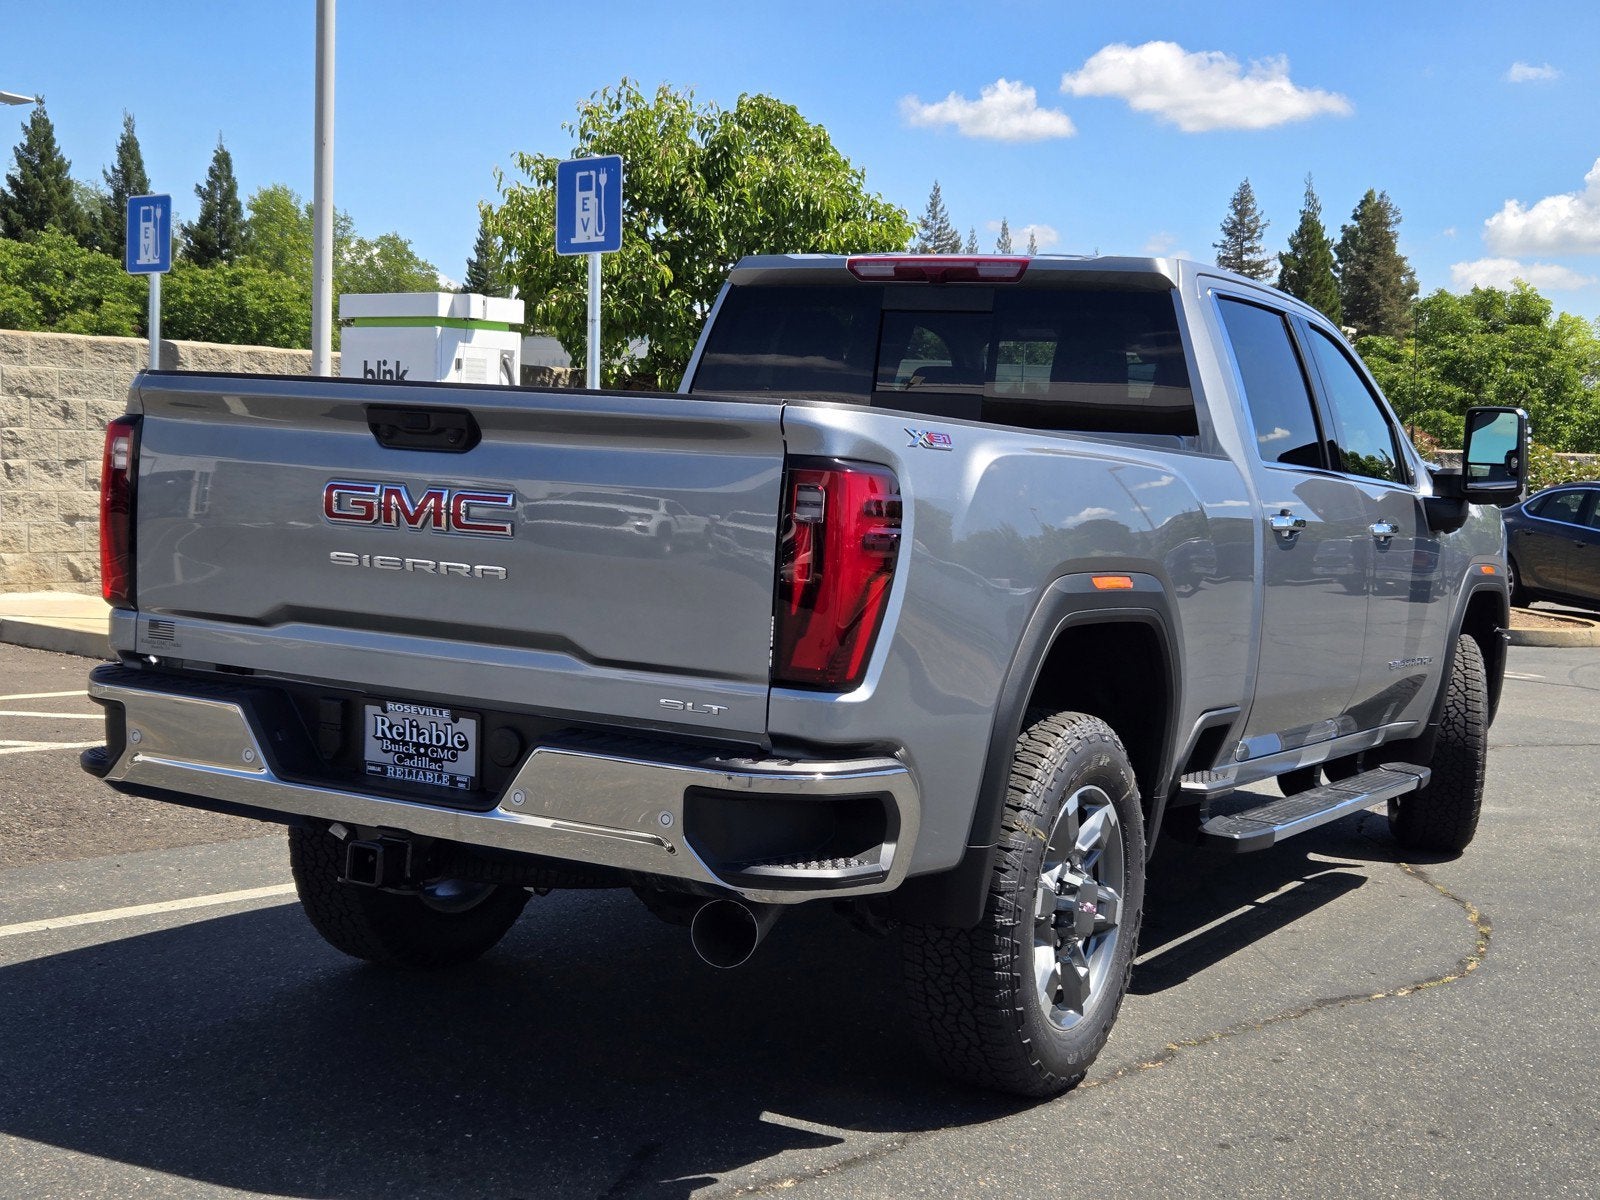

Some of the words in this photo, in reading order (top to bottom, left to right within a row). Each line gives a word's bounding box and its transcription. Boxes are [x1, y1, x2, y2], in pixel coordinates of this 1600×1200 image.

[581, 196, 591, 233] EV
[143, 226, 151, 256] EV
[363, 359, 408, 381] blink
[322, 479, 514, 538] GMC
[329, 551, 508, 580] SIERRA
[386, 702, 451, 719] ROSEVILLE
[659, 698, 729, 716] SLT
[373, 714, 468, 750] Reliable
[381, 738, 417, 754] Buick
[427, 746, 459, 762] GMC
[393, 753, 443, 772] Cadillac
[385, 765, 450, 786] RELIABLE
